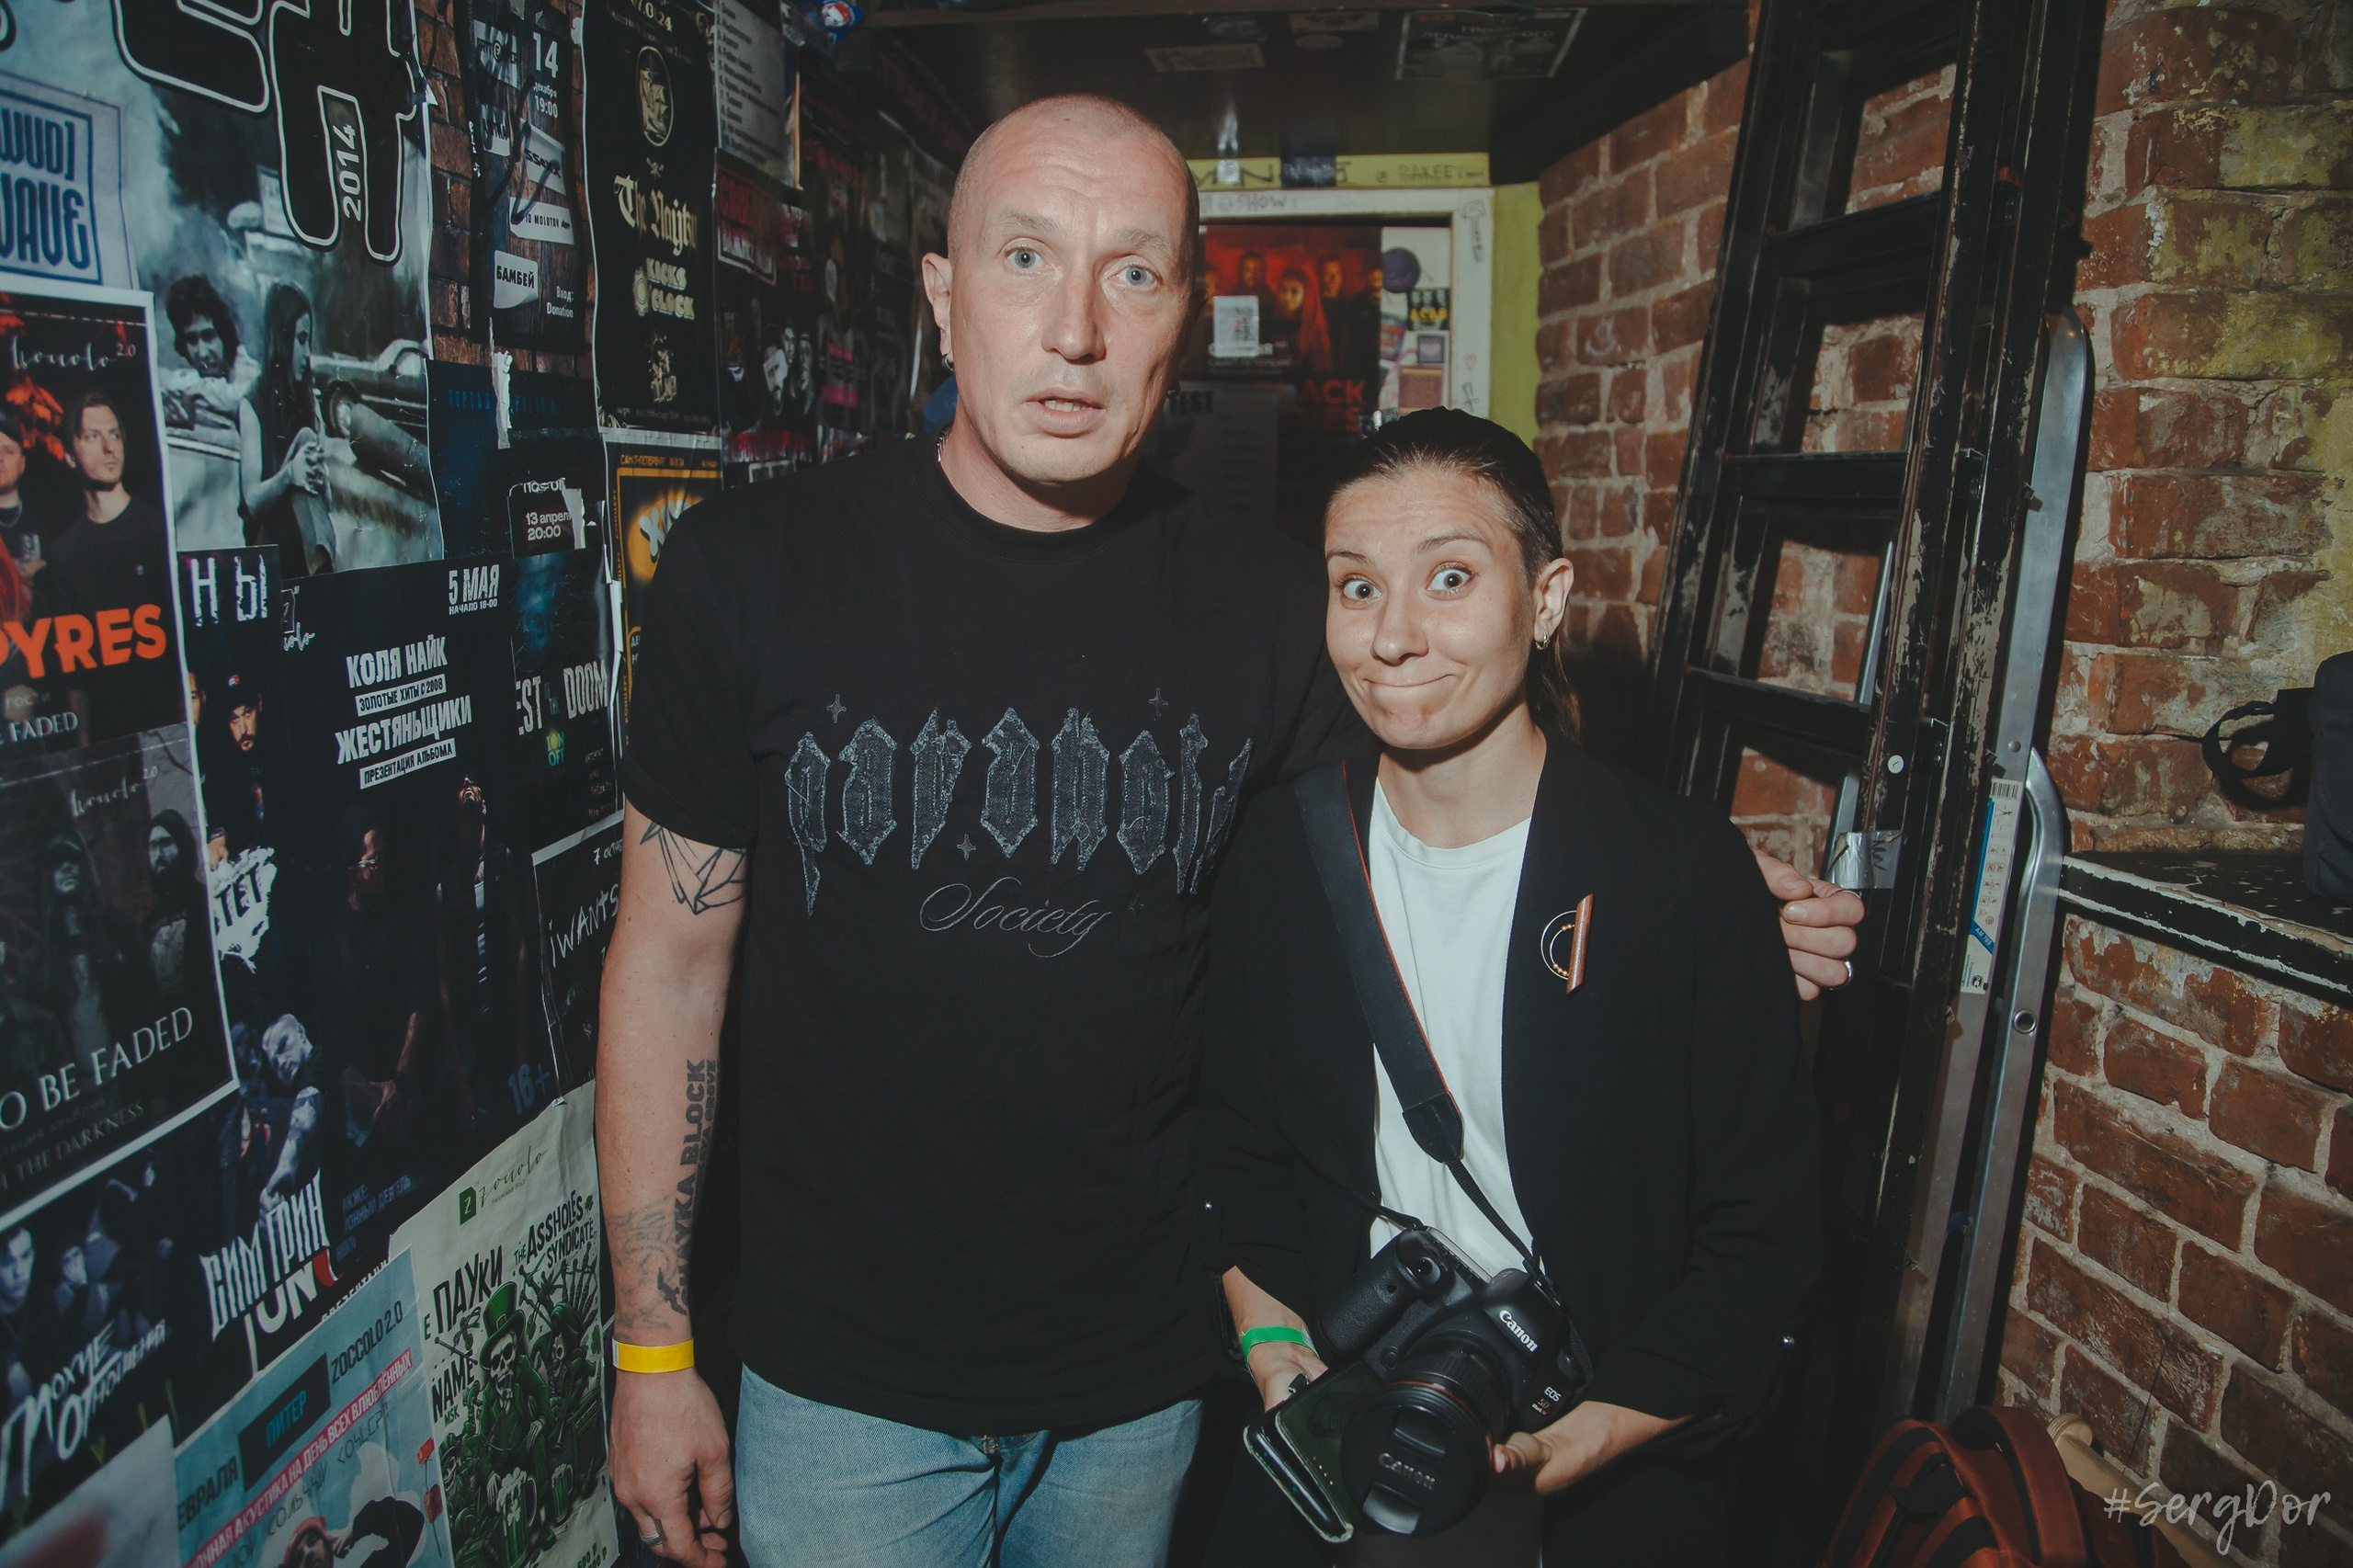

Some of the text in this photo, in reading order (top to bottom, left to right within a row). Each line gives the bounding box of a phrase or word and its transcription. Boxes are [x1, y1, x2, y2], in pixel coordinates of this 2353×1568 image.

[533, 32, 558, 78] 14
[535, 95, 559, 119] 19:00
[334, 123, 362, 222] 2014
[534, 214, 560, 229] MOLOTOV
[496, 265, 535, 290] БАМБЕЙ
[556, 286, 574, 302] Вход:
[646, 256, 688, 291] KICKS
[547, 302, 574, 319] Donation
[526, 512, 573, 526] 13 апрел
[528, 525, 561, 541] 20:00
[449, 564, 500, 605] 5 МАЯ
[449, 598, 498, 615] НАЧАЛО 18-00
[347, 634, 448, 687] КОЛЯ НАЙК
[359, 677, 444, 711] ЗОЛОТЫЕ ХИТЫ С 2008
[563, 659, 608, 719] DOOM
[8, 711, 79, 743] FADED
[335, 695, 472, 765] ЖЕСТЯНЬЩИКИ
[364, 742, 453, 785] ПРЕЗЕНТАЦИЯ АЛЬБОМА
[548, 747, 564, 767] OFF
[593, 846, 600, 865] 7
[919, 876, 1111, 958] Society
[39, 1063, 80, 1112] BE
[91, 1007, 193, 1085] FADED
[508, 1062, 551, 1116] 16+
[56, 1103, 144, 1160] DARKNESS
[679, 1059, 706, 1166] BLOCK
[514, 1242, 527, 1265] THE
[526, 1189, 584, 1265] ASSHOLES
[546, 1218, 594, 1268] SYNDICATE
[433, 1244, 503, 1334] ПАУКИ
[331, 1300, 404, 1384] ZOCCOLO 2.0
[1498, 1310, 1539, 1353] Canon
[431, 1351, 476, 1424] NAME
[1544, 1386, 1562, 1402] EOS
[265, 1389, 308, 1449] ПИТЕР
[444, 1403, 460, 1428] MSK
[233, 1477, 288, 1535] АКУСТИКА
[289, 1460, 302, 1481] НА
[304, 1434, 328, 1471] ДЕНЬ
[328, 1413, 352, 1442] ВСЕХ
[352, 1349, 412, 1422] ВЛЮБЛЁННЫХ
[177, 1455, 239, 1531] ЕВРАЛЯ
[1379, 1452, 1437, 1491] Canon
